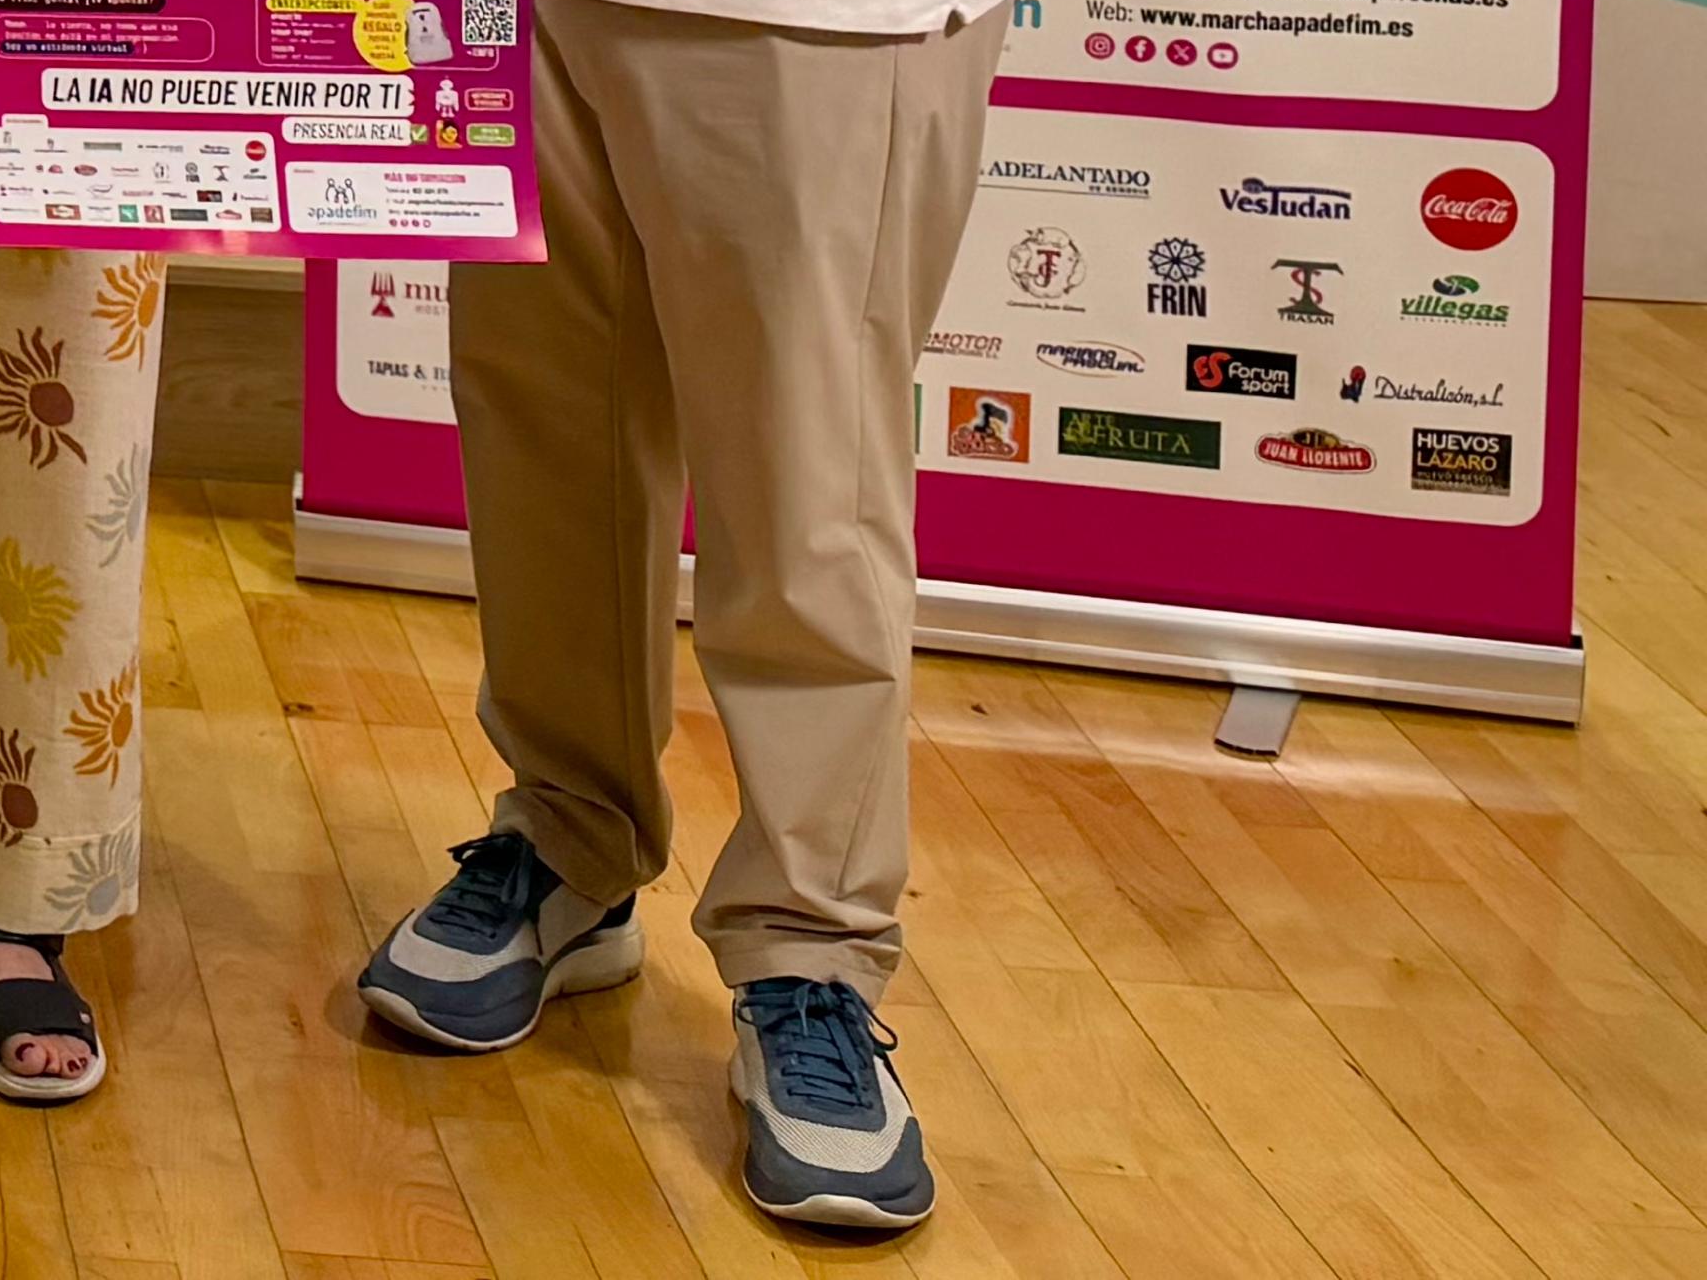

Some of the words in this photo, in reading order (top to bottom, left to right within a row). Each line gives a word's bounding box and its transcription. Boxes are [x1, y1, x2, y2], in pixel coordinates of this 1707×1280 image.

[1086, 0, 1133, 22] Web:
[1141, 9, 1413, 39] www.marchaapadefim.es
[52, 79, 81, 103] LA
[89, 79, 113, 103] IA
[120, 80, 153, 105] NO
[161, 80, 238, 106] PUEDE
[245, 81, 316, 109] VENIR
[323, 82, 373, 109] POR
[379, 83, 402, 110] TI
[989, 161, 1150, 187] ADELANTADO
[1147, 283, 1207, 317] FRIN
[1401, 295, 1509, 322] villegas
[1417, 432, 1499, 453] HUEVOS
